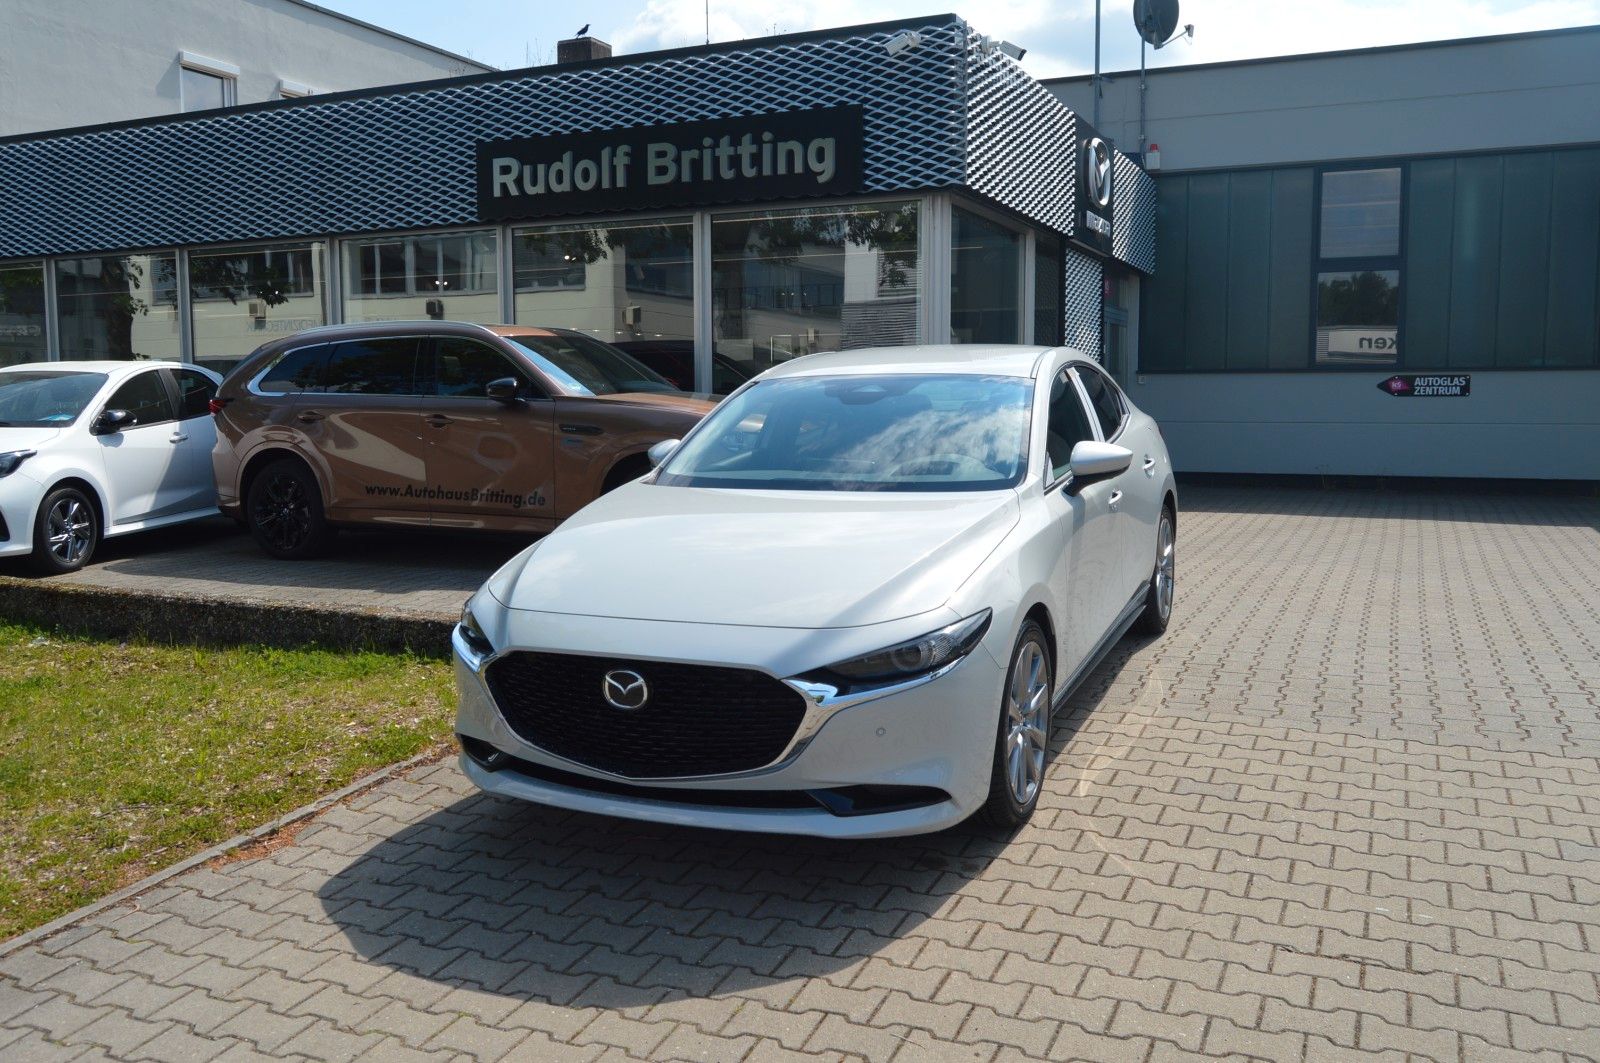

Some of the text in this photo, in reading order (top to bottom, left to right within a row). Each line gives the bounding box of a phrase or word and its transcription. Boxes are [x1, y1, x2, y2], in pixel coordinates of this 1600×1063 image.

[492, 130, 837, 198] Rudolf Britting
[1413, 376, 1466, 386] AUTOGLAS
[1413, 386, 1461, 395] ZENTRUM
[364, 484, 547, 509] www.AutohausBritting.de
